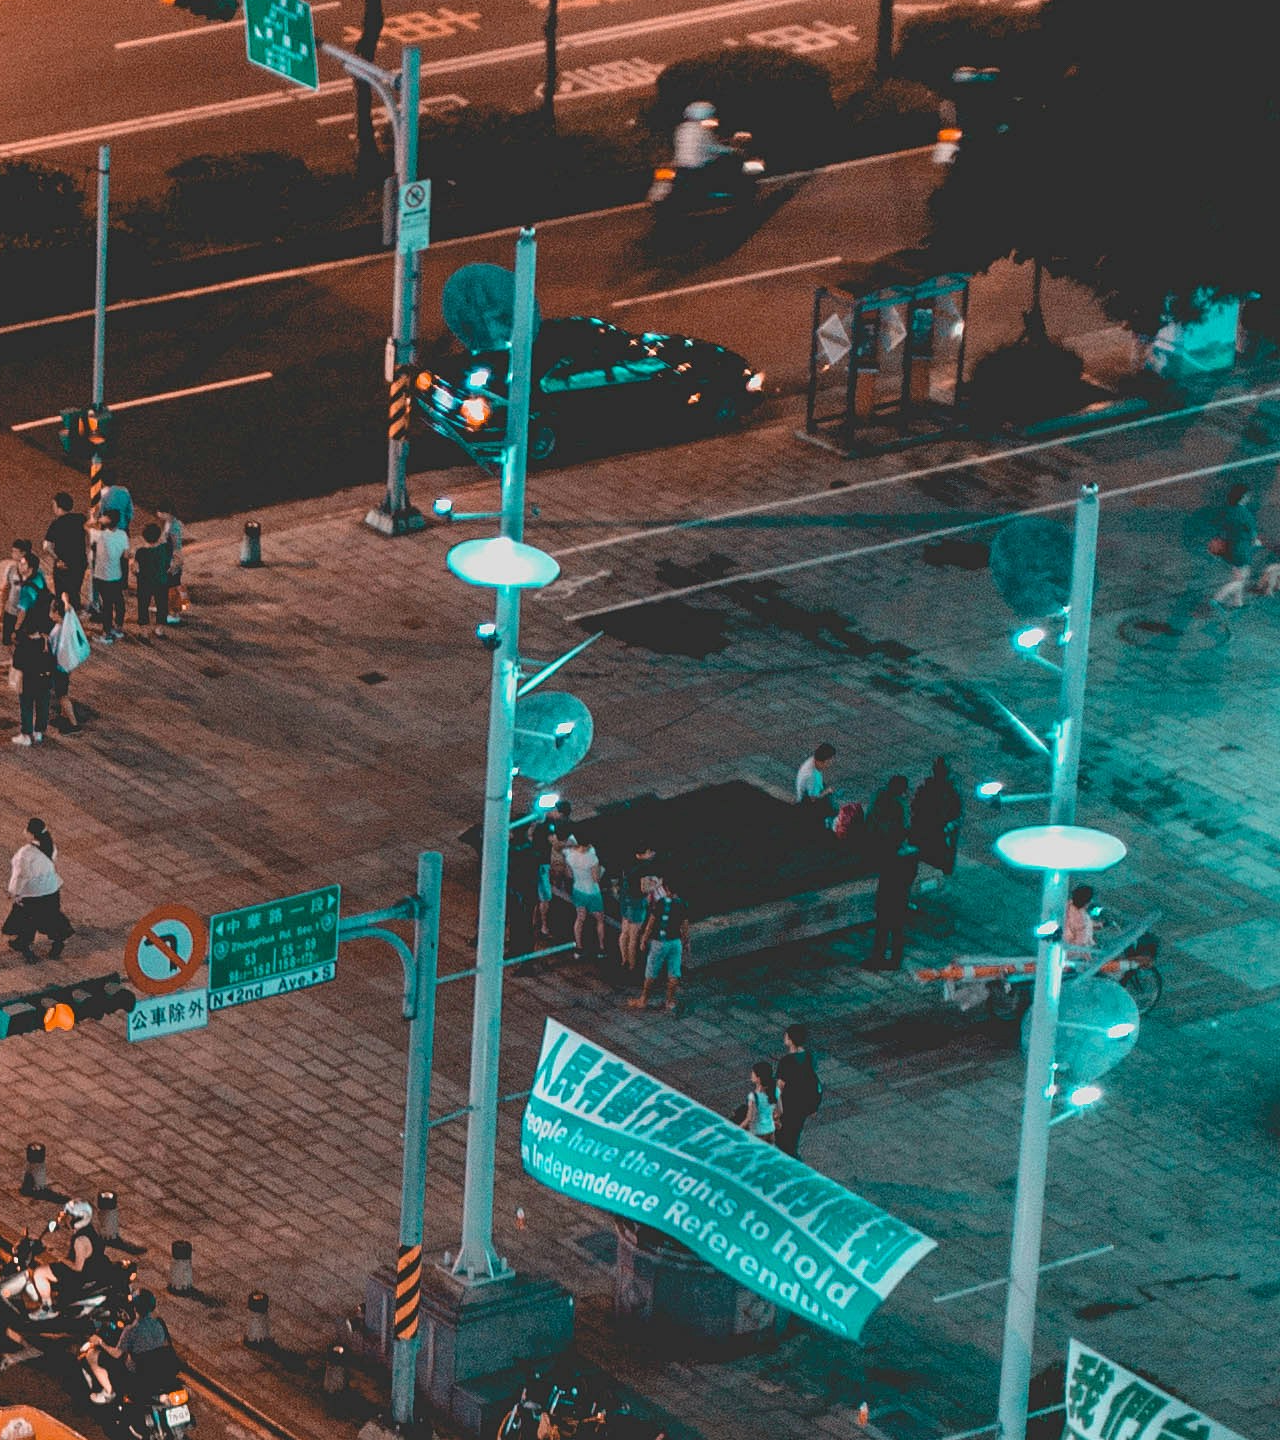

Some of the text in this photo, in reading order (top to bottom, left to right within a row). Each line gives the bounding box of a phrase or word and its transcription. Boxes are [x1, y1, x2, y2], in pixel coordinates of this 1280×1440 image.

[213, 994, 224, 1007] N
[236, 984, 264, 1001] 2nd
[322, 966, 332, 979] S
[131, 997, 204, 1031] 公車除外
[533, 1144, 660, 1212] Independence
[568, 1128, 619, 1162] have
[620, 1149, 661, 1177] the
[659, 1167, 738, 1217] rights
[740, 1209, 770, 1241] to
[771, 1229, 860, 1309] hold
